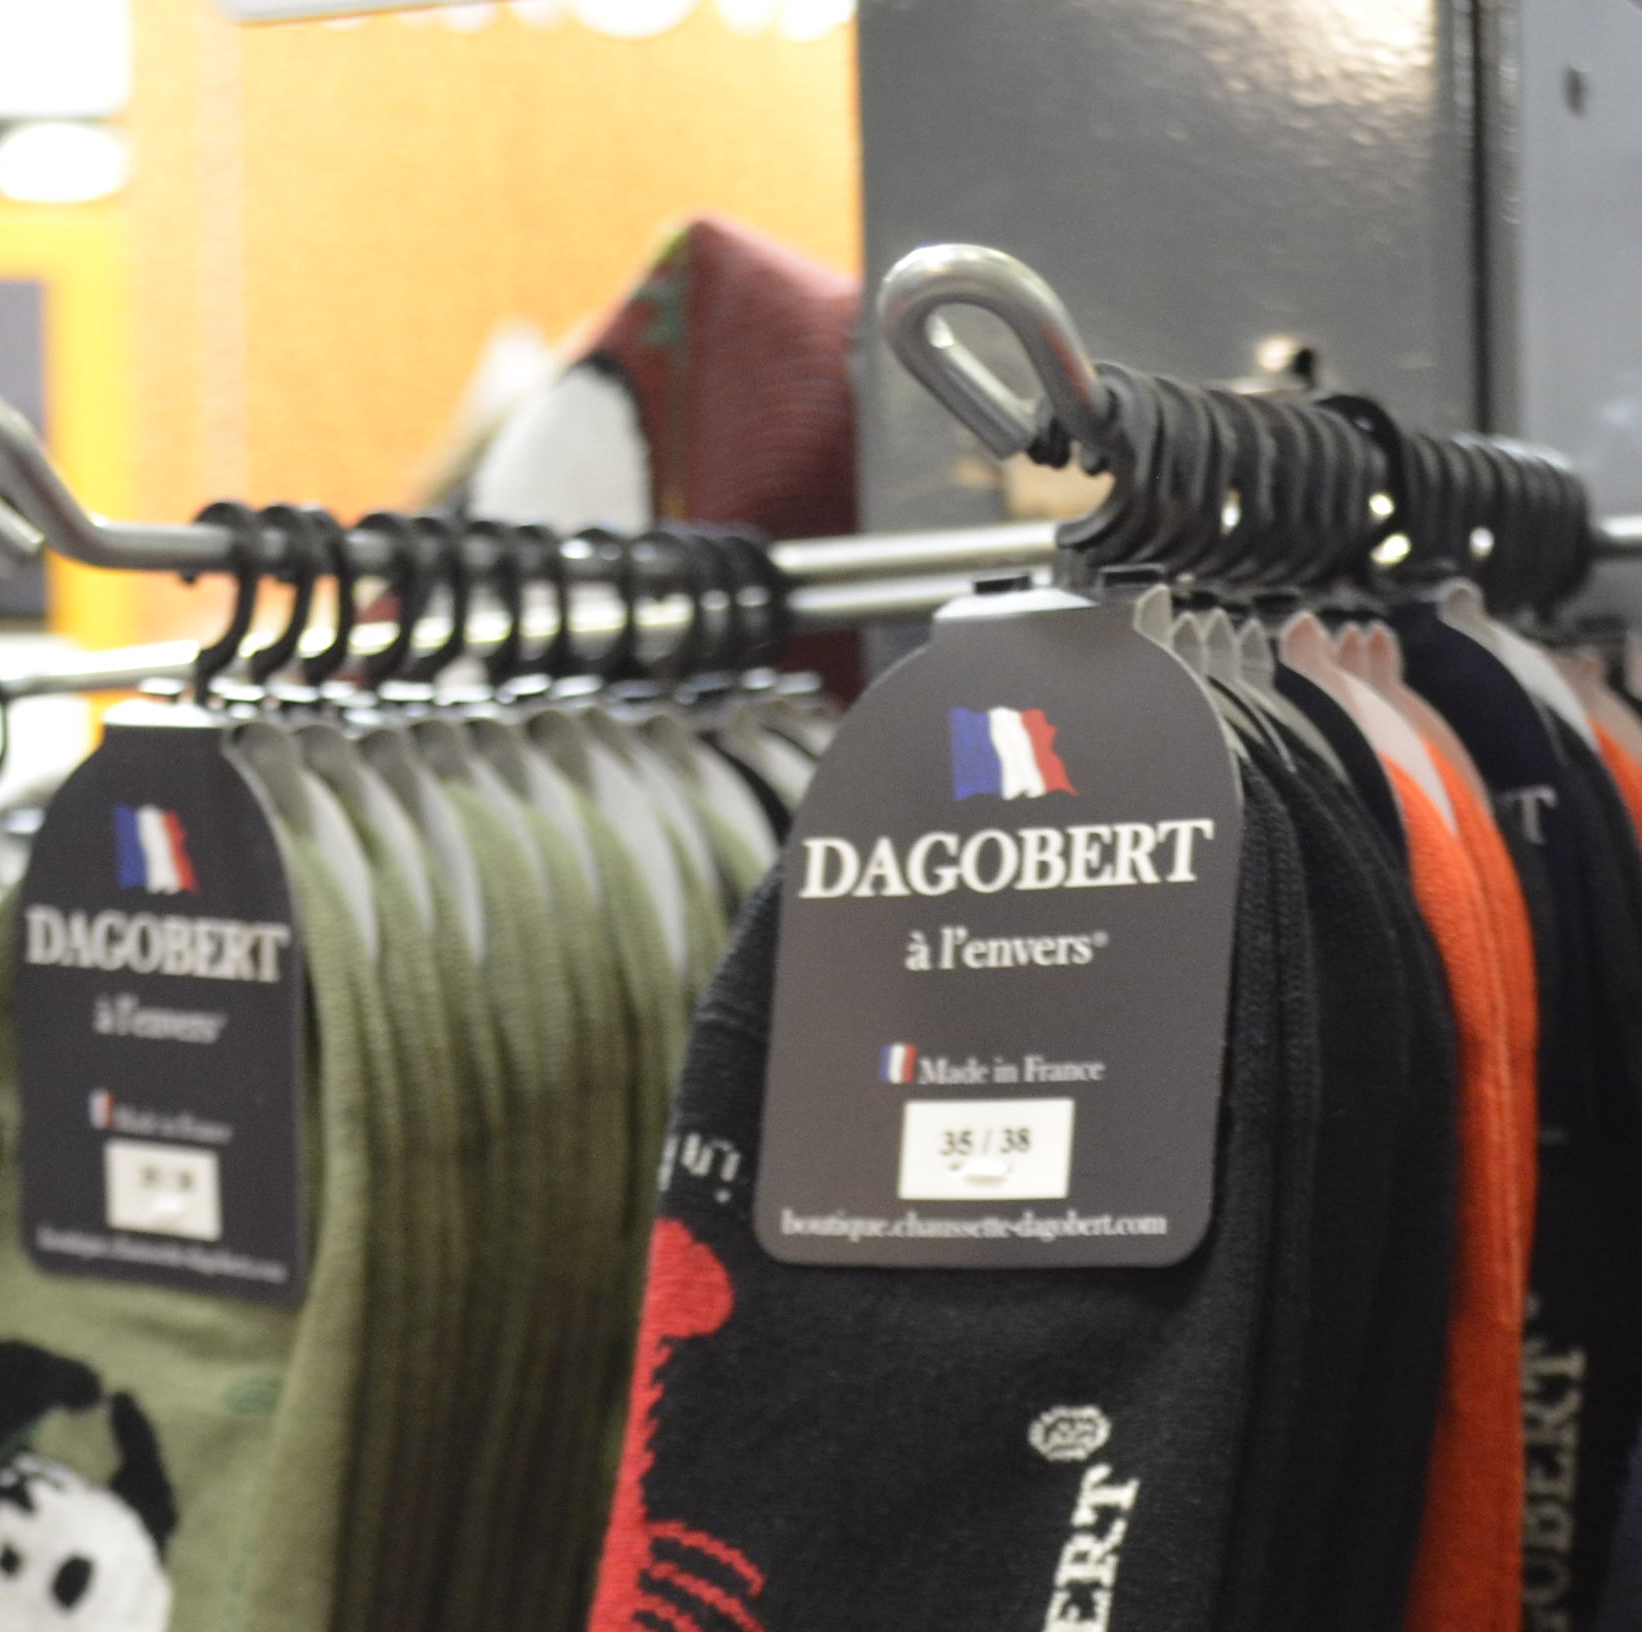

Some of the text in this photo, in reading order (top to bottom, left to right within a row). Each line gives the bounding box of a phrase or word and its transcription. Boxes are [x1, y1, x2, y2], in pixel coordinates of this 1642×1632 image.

[800, 820, 1214, 898] DAGOBERT
[25, 905, 289, 982] DAGOBERT
[906, 930, 930, 971] à
[918, 1058, 1105, 1085] Made in France
